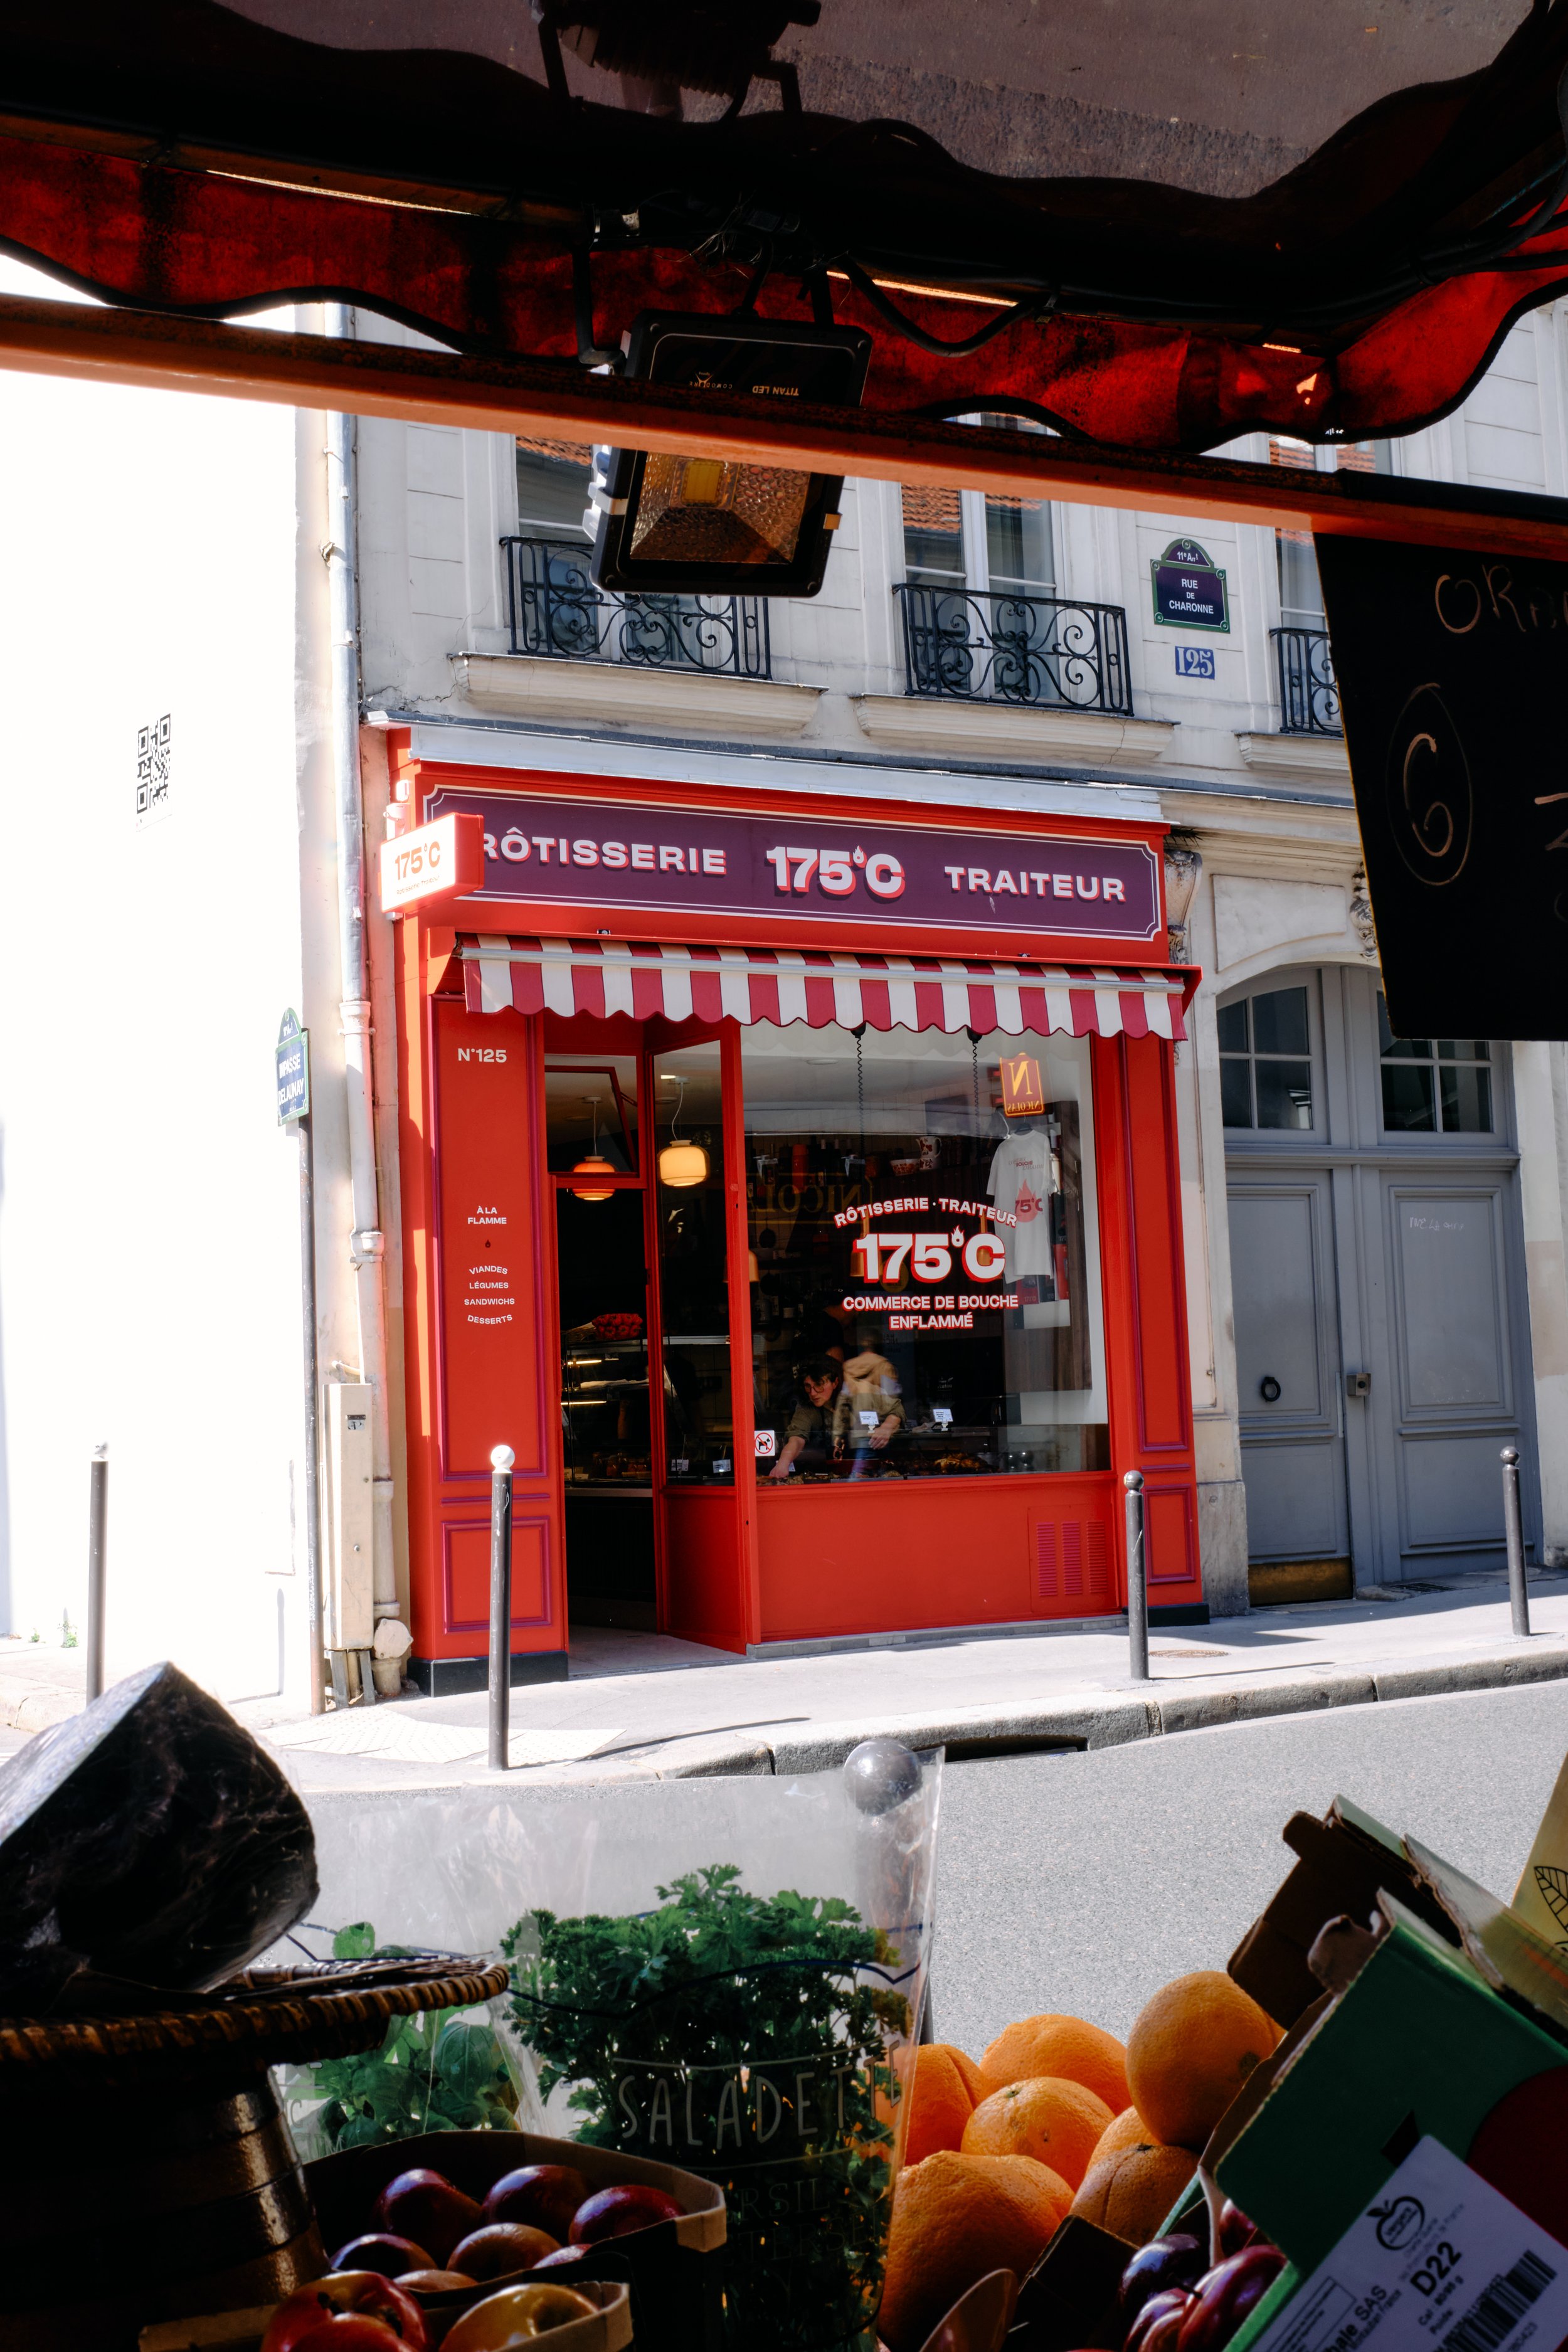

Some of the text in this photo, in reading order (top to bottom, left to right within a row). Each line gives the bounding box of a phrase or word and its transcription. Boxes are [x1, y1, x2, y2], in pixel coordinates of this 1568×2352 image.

[752, 385, 800, 396] TITAN LED
[1181, 578, 1198, 589] RUE
[1169, 600, 1214, 614] CHARONNE
[1177, 647, 1213, 676] 125
[395, 840, 440, 881] 175°C
[483, 827, 727, 874] RÔTISSERIE
[766, 845, 905, 898] 175°C
[944, 866, 1126, 902] TRAITEUR
[279, 1054, 301, 1079] IMPASSE
[458, 1048, 507, 1062] N°125
[278, 1078, 304, 1106] DELAUNAY
[477, 1205, 484, 1214] À
[834, 1197, 1017, 1228] RÔTISSERIE TRAITEUR
[853, 1225, 1006, 1283] 175°C
[469, 1265, 508, 1274] VIANDES
[469, 1281, 509, 1289] LÉGUMES
[842, 1295, 930, 1312] COMMERCE
[935, 1296, 955, 1311] DE
[958, 1295, 1019, 1311] BOUCHE
[467, 1315, 512, 1324] DESSERTS
[889, 1311, 973, 1330] ENFLAMMÉ
[618, 2040, 902, 2150] SALADETTE
[1410, 2241, 1461, 2296] D22
[1352, 2282, 1389, 2323] SAS
